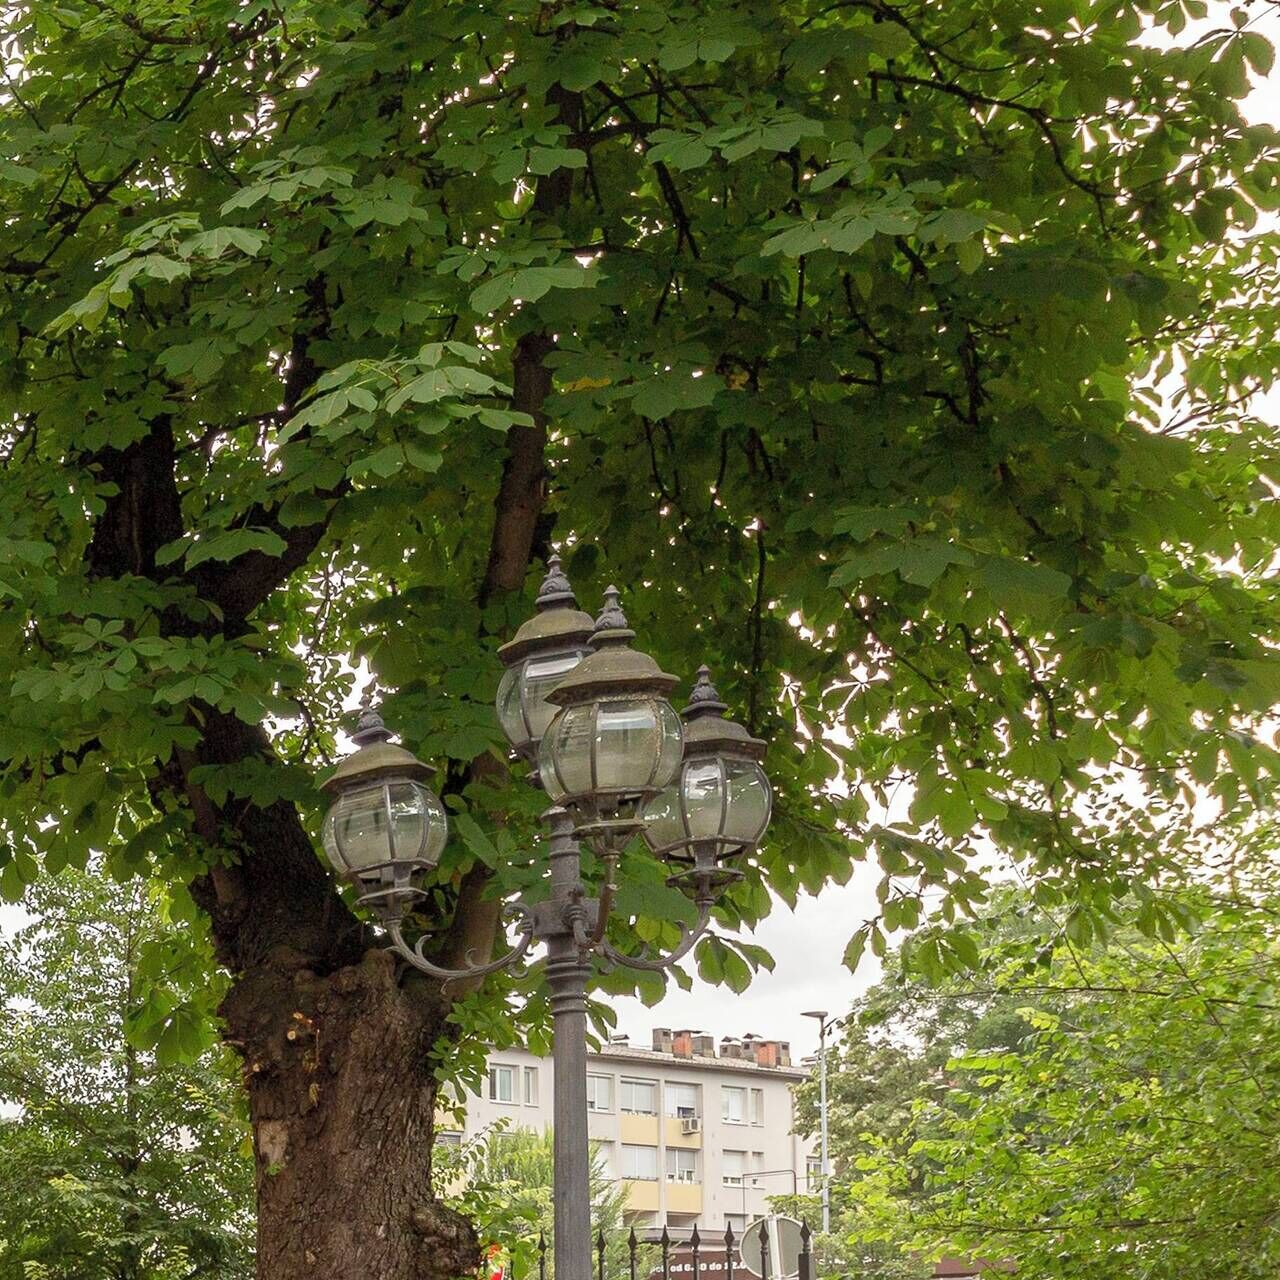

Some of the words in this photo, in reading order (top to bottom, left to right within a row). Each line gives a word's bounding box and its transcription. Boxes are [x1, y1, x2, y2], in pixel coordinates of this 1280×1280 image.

[670, 1263, 683, 1272] od
[684, 1262, 707, 1272] 6.0
[708, 1261, 722, 1271] do
